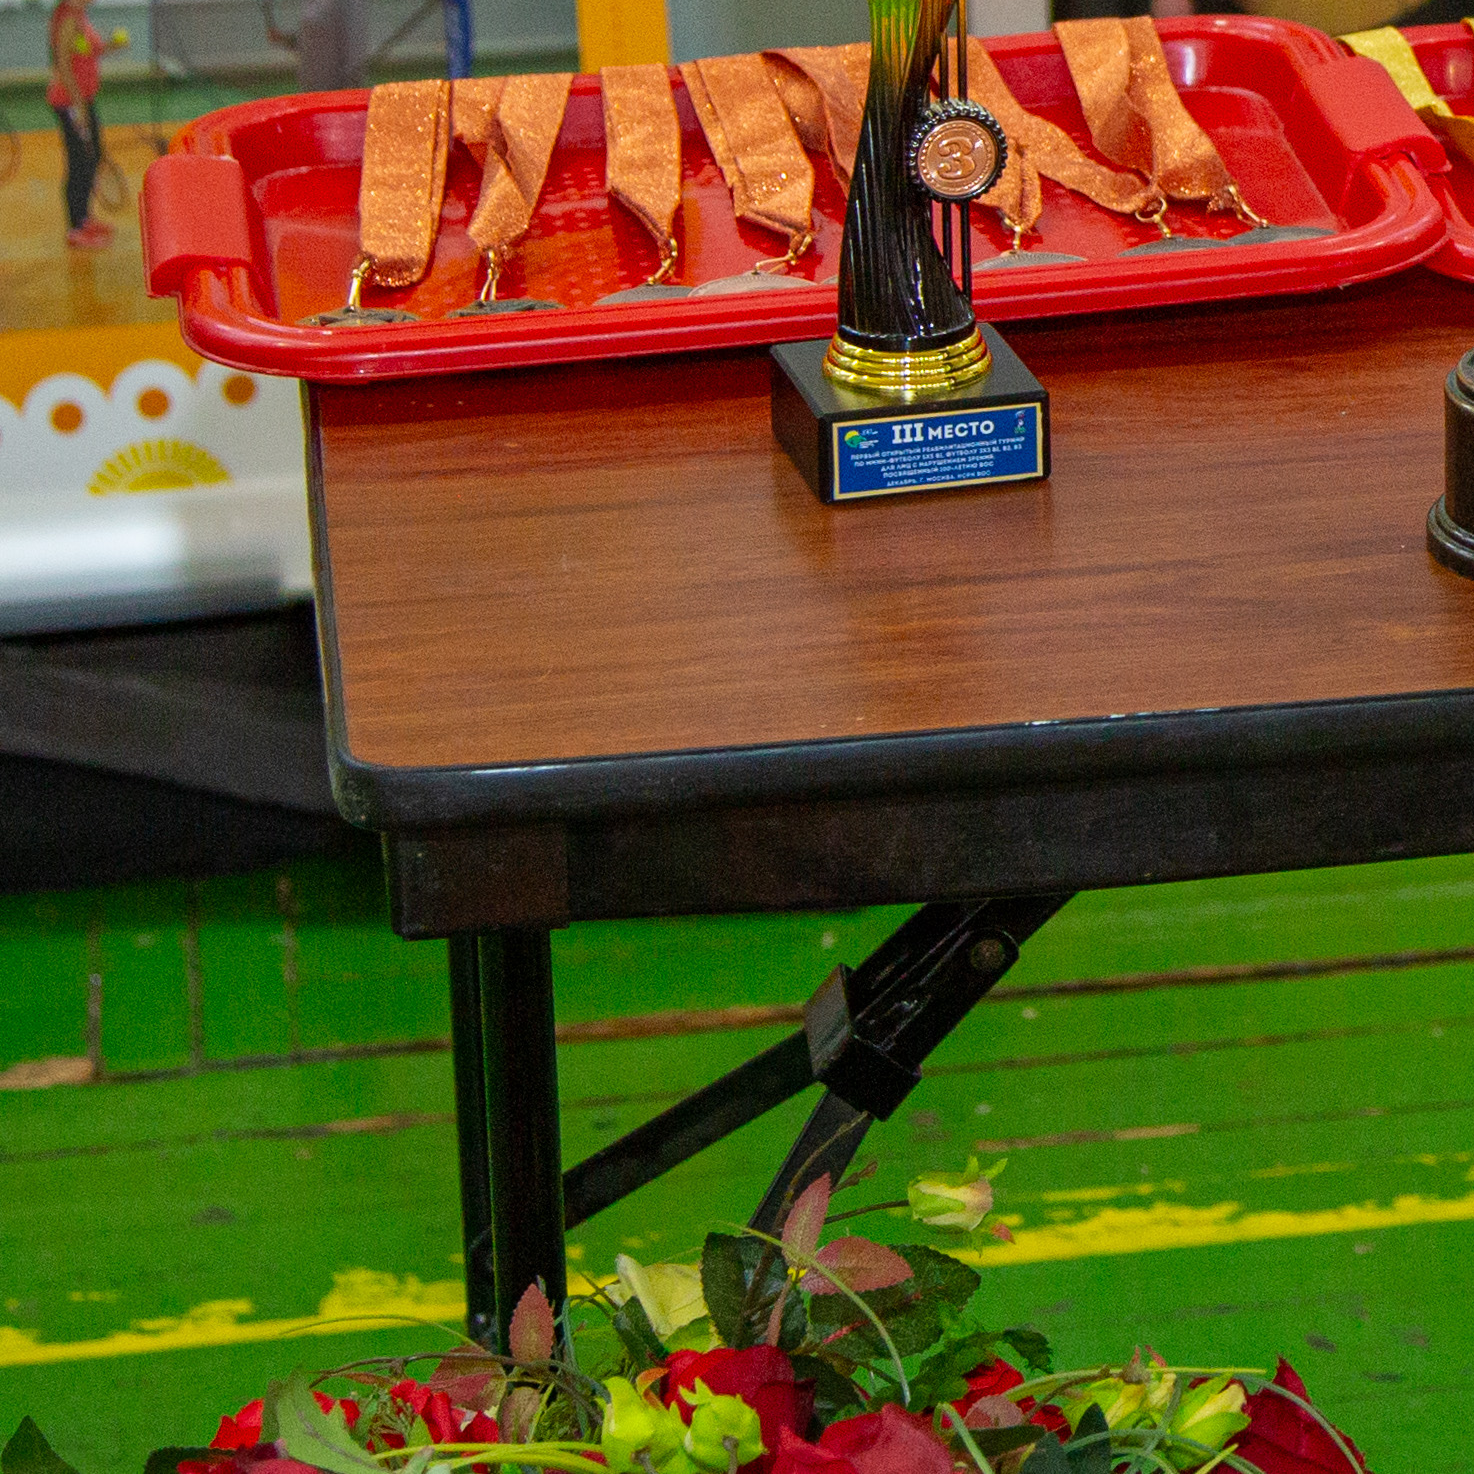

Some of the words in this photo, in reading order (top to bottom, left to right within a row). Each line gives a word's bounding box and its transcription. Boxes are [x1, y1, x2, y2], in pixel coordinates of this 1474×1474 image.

[937, 135, 976, 180] 3
[892, 423, 924, 444] III
[928, 421, 995, 440] МЕСТО
